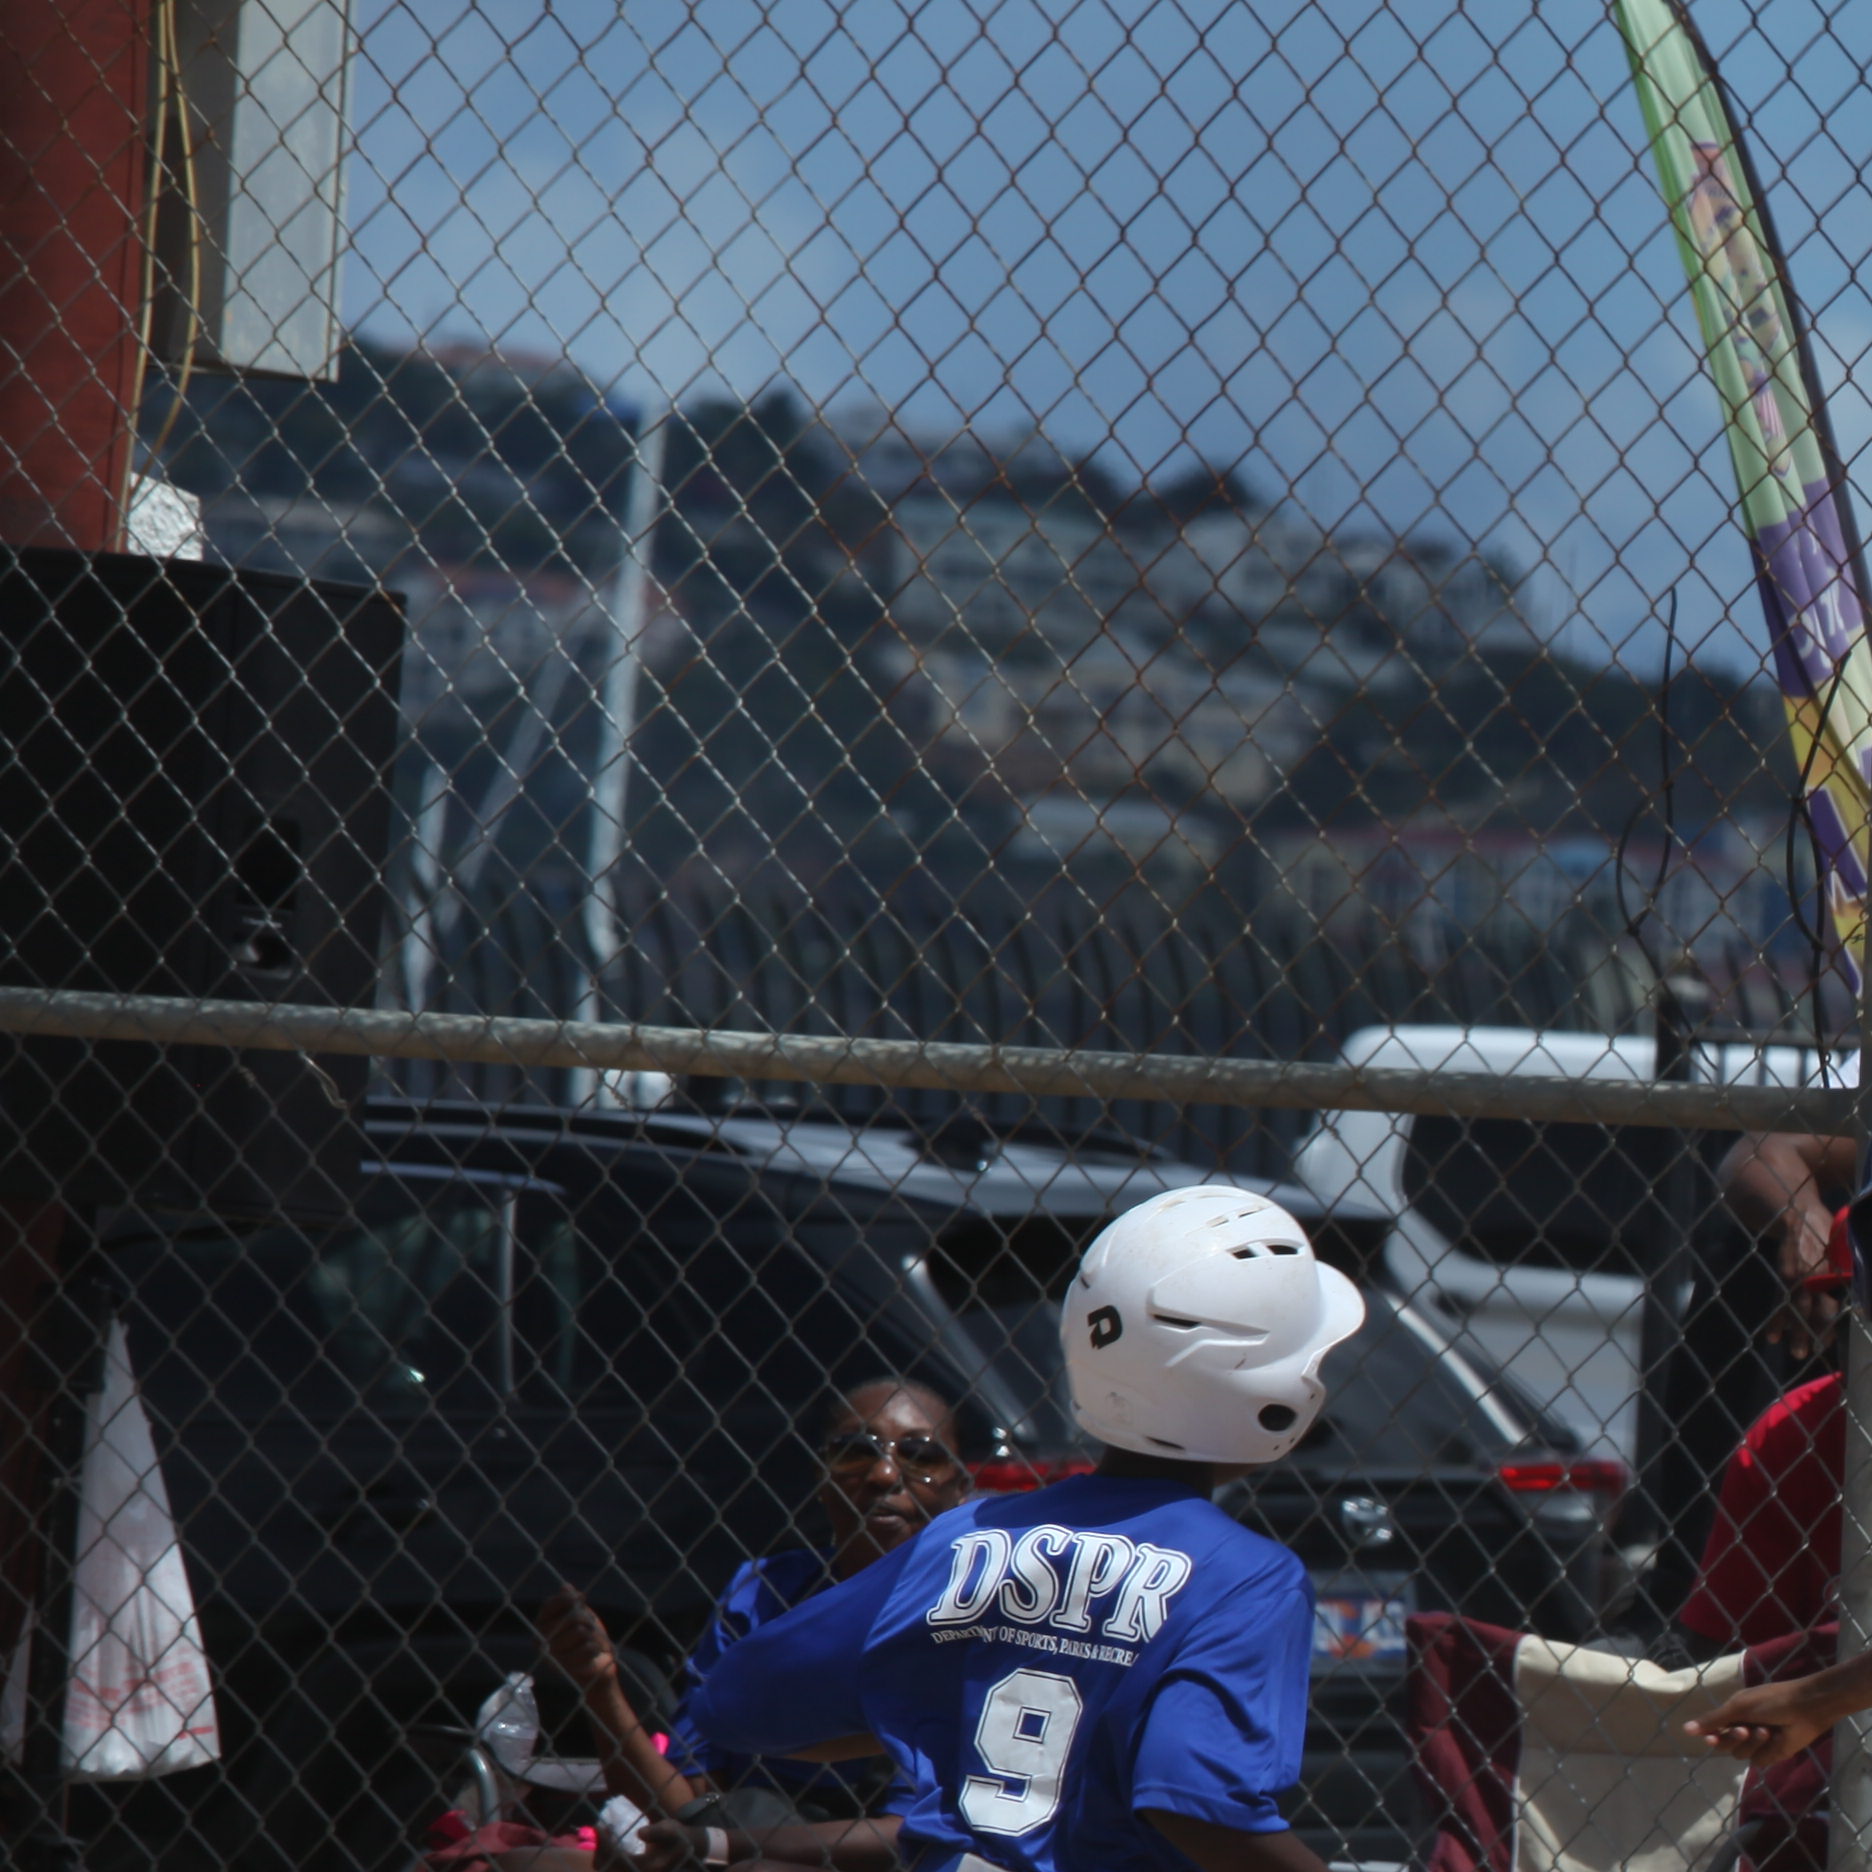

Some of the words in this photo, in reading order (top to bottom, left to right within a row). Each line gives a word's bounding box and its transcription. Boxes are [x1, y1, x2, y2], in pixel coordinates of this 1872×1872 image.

[926, 1524, 1192, 1643] DSPR
[1000, 1626, 1016, 1643] OF
[1016, 1629, 1058, 1655] SPORTS,
[1059, 1638, 1091, 1659] PARKS
[958, 1667, 1083, 1837] 9
